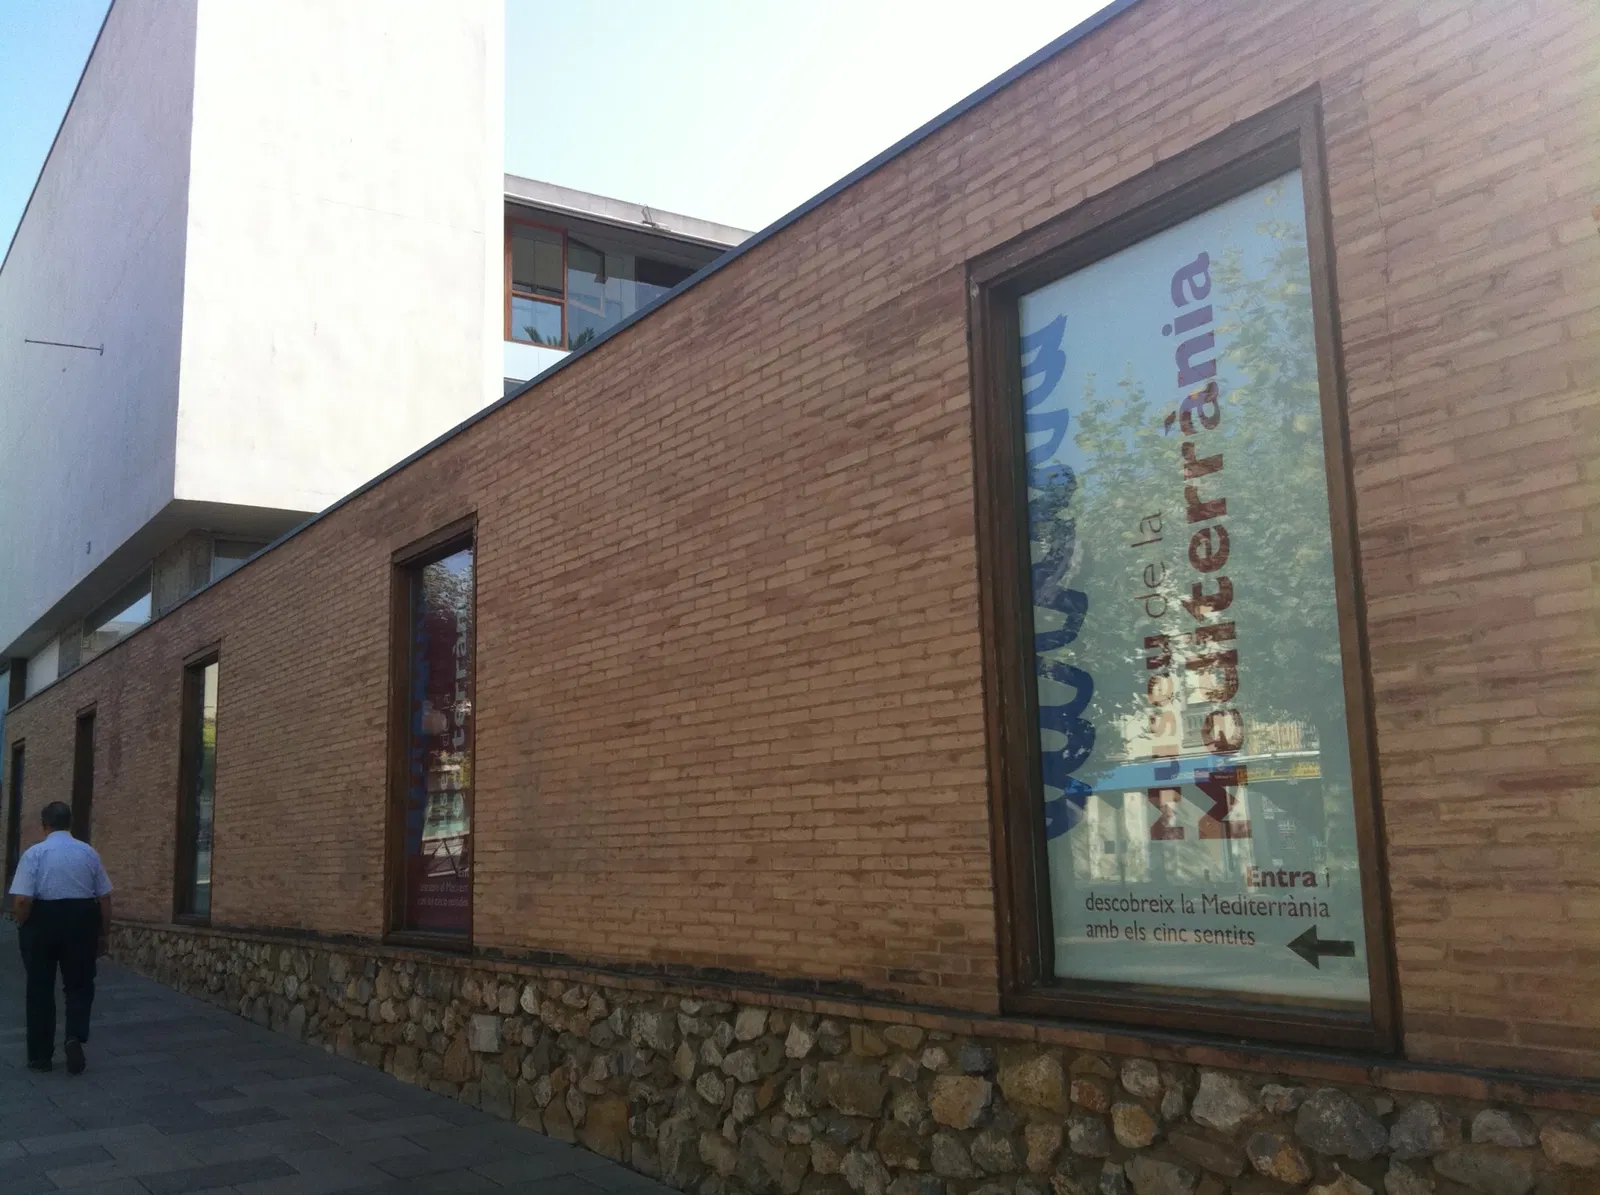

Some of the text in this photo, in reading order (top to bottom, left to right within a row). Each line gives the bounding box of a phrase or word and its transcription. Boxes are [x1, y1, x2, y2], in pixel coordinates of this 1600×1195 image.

[1162, 251, 1252, 839] Mediterrània
[1131, 510, 1185, 841] Museu de la
[1246, 865, 1318, 888] Entra
[1085, 891, 1331, 918] descobreix la Mediterrània
[1086, 918, 1256, 946] amb els cinc sentits
